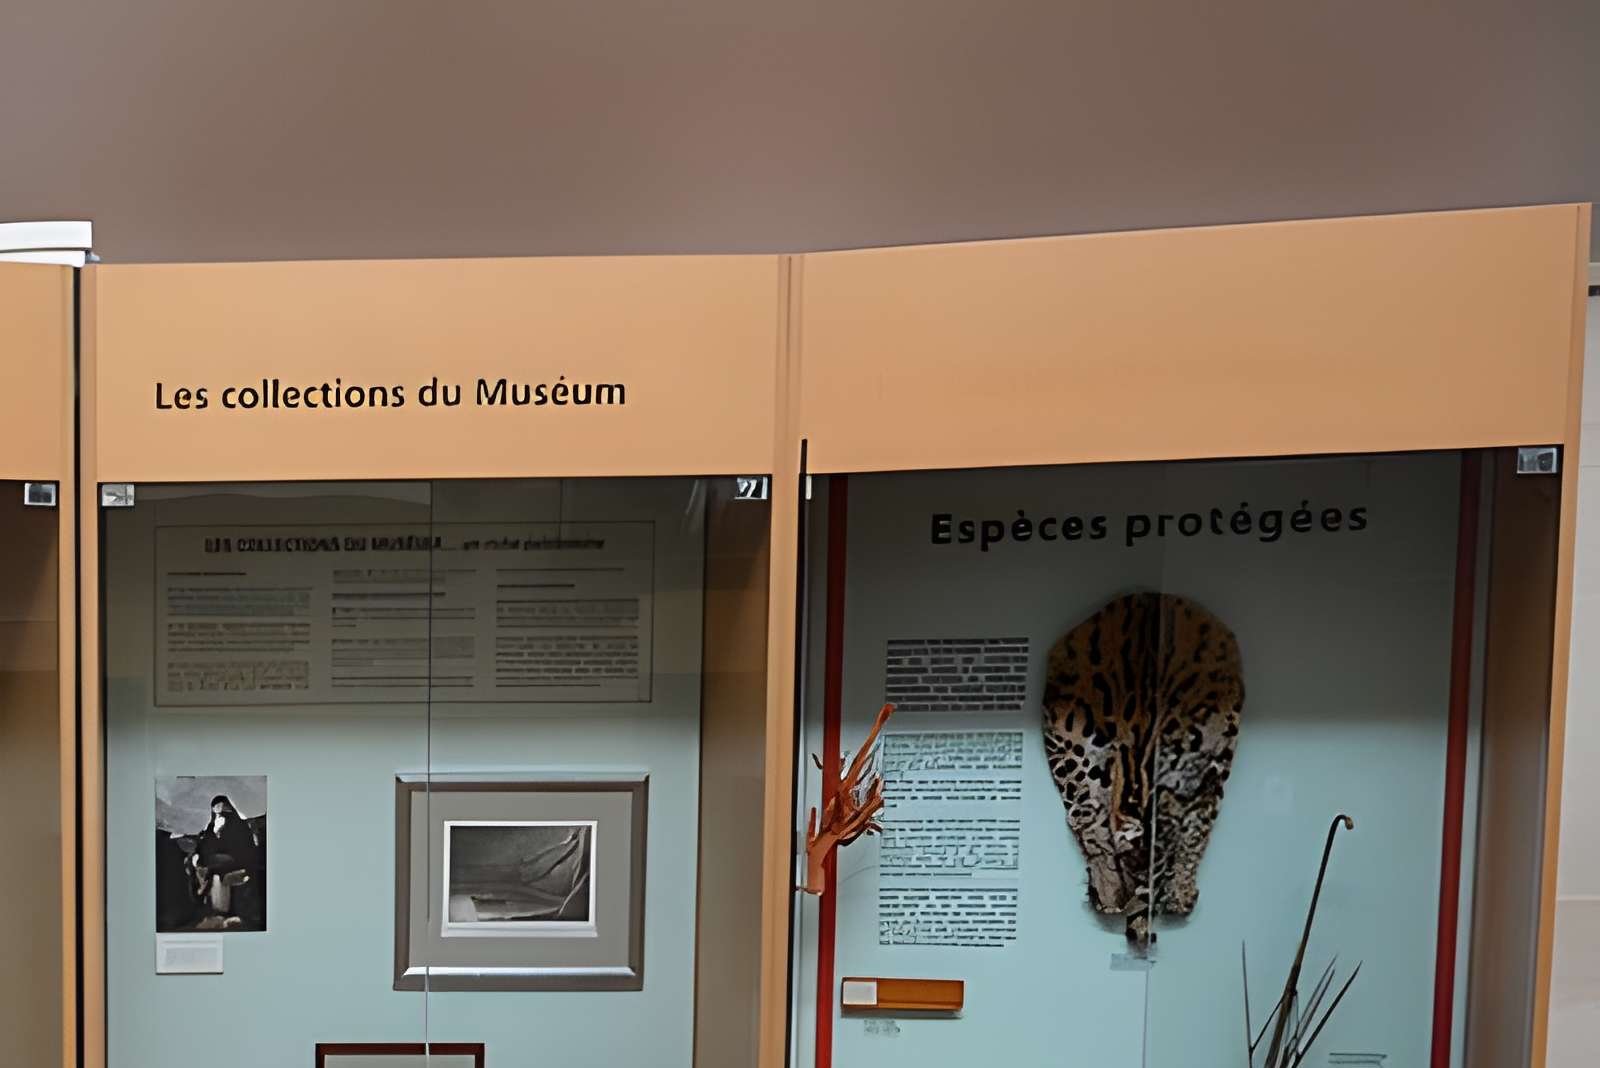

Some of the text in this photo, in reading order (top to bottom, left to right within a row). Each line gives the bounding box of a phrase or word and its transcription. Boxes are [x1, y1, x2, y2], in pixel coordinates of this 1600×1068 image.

[155, 375, 626, 410] Les collections du Muséum
[930, 499, 1368, 553] Espèces protégées
